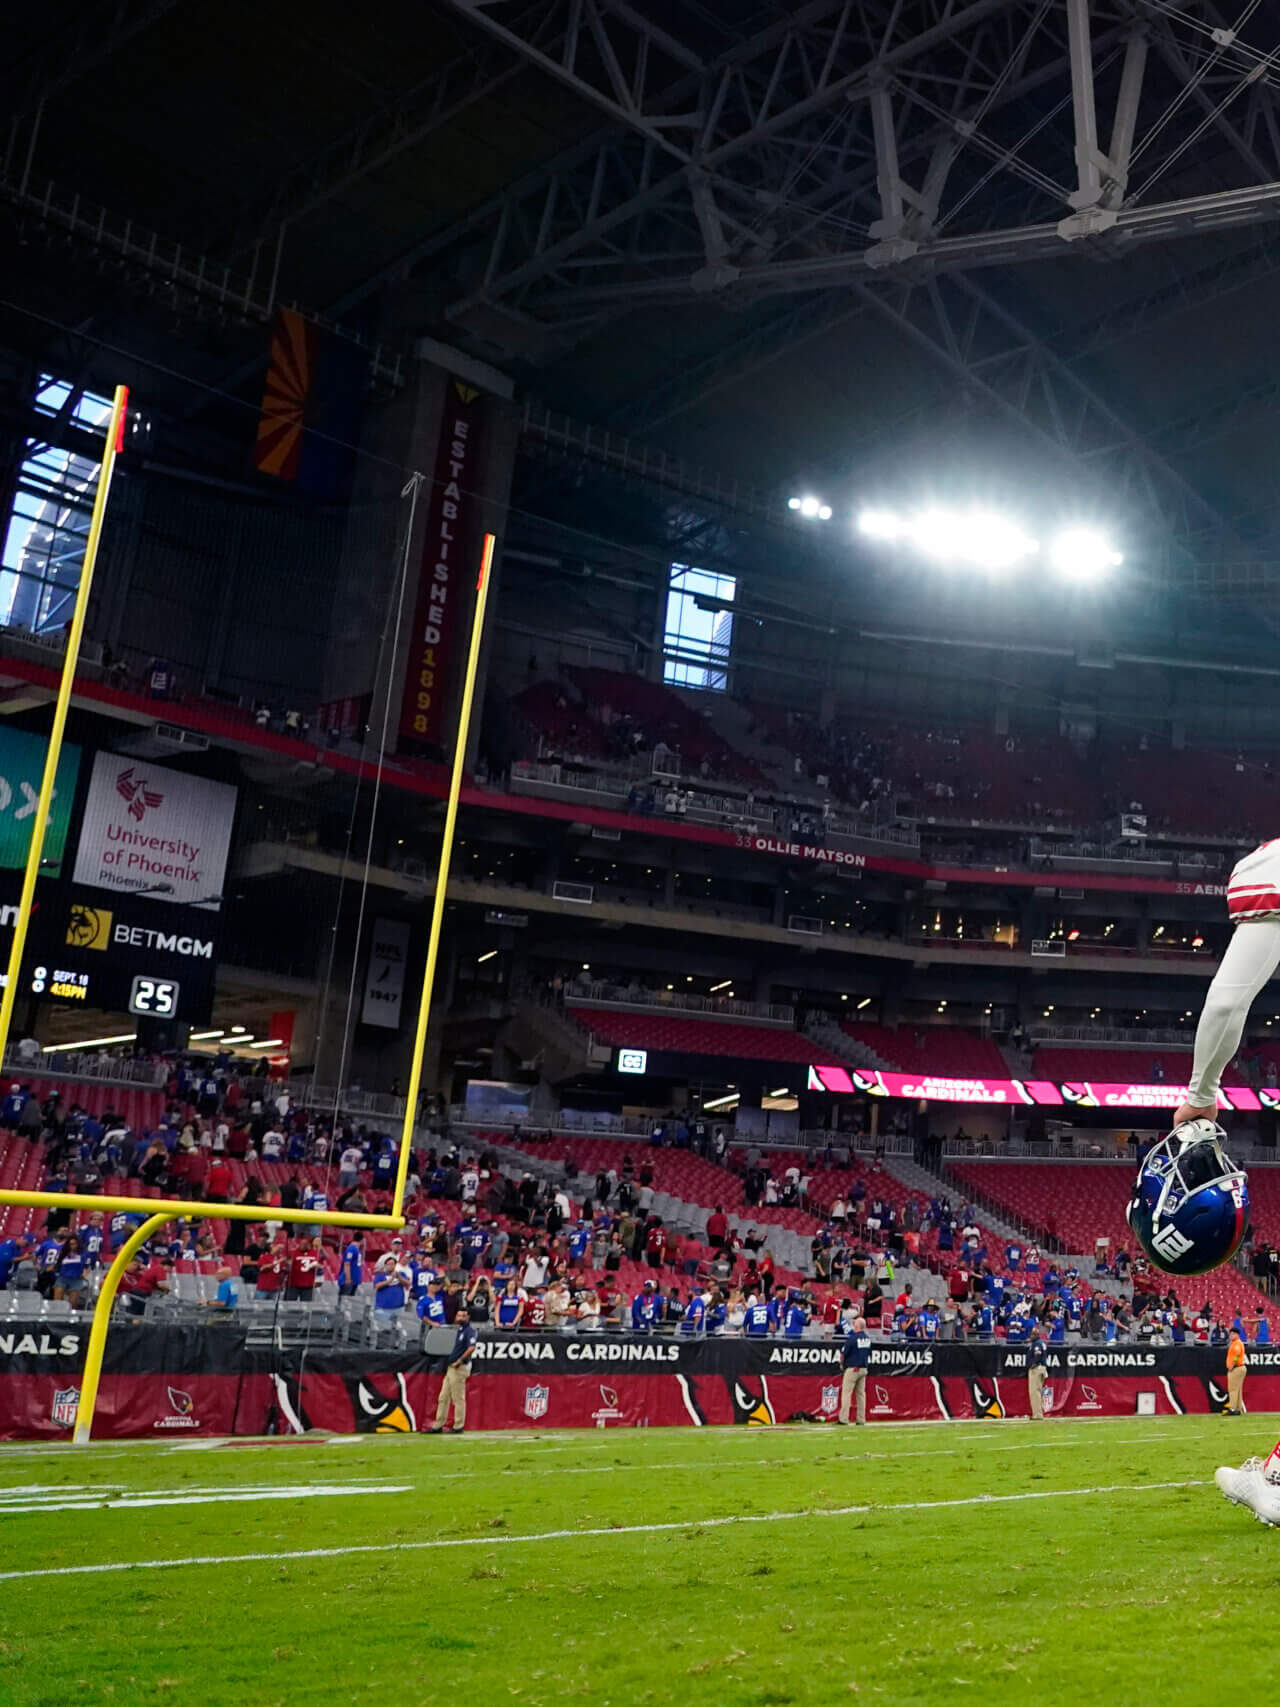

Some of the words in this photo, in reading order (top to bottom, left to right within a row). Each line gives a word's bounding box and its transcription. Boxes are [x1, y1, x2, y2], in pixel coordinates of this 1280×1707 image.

[425, 419, 469, 645] ESTABLISHED
[413, 649, 436, 733] 1898
[106, 823, 200, 862] University
[735, 836, 752, 848] 33
[755, 839, 800, 856] OLLIE
[803, 846, 866, 867] MATSON
[103, 849, 126, 868] of
[127, 852, 201, 883] Phoenix
[113, 923, 214, 960] BETMGM
[134, 980, 173, 1013] 25
[922, 1078, 985, 1090] ARIZONA
[901, 1085, 1006, 1102] CARDINALS
[1105, 1093, 1189, 1108] CARDINA
[752, 1309, 767, 1325] 26
[471, 1342, 556, 1359] RIZONA
[566, 1343, 680, 1361] CARDINALS
[769, 1348, 842, 1363] ARIZONA
[1004, 1354, 1061, 1367] ARINA
[1067, 1353, 1156, 1367] CARDINALS
[57, 1406, 79, 1421] NF
[527, 1400, 544, 1412] NFL
